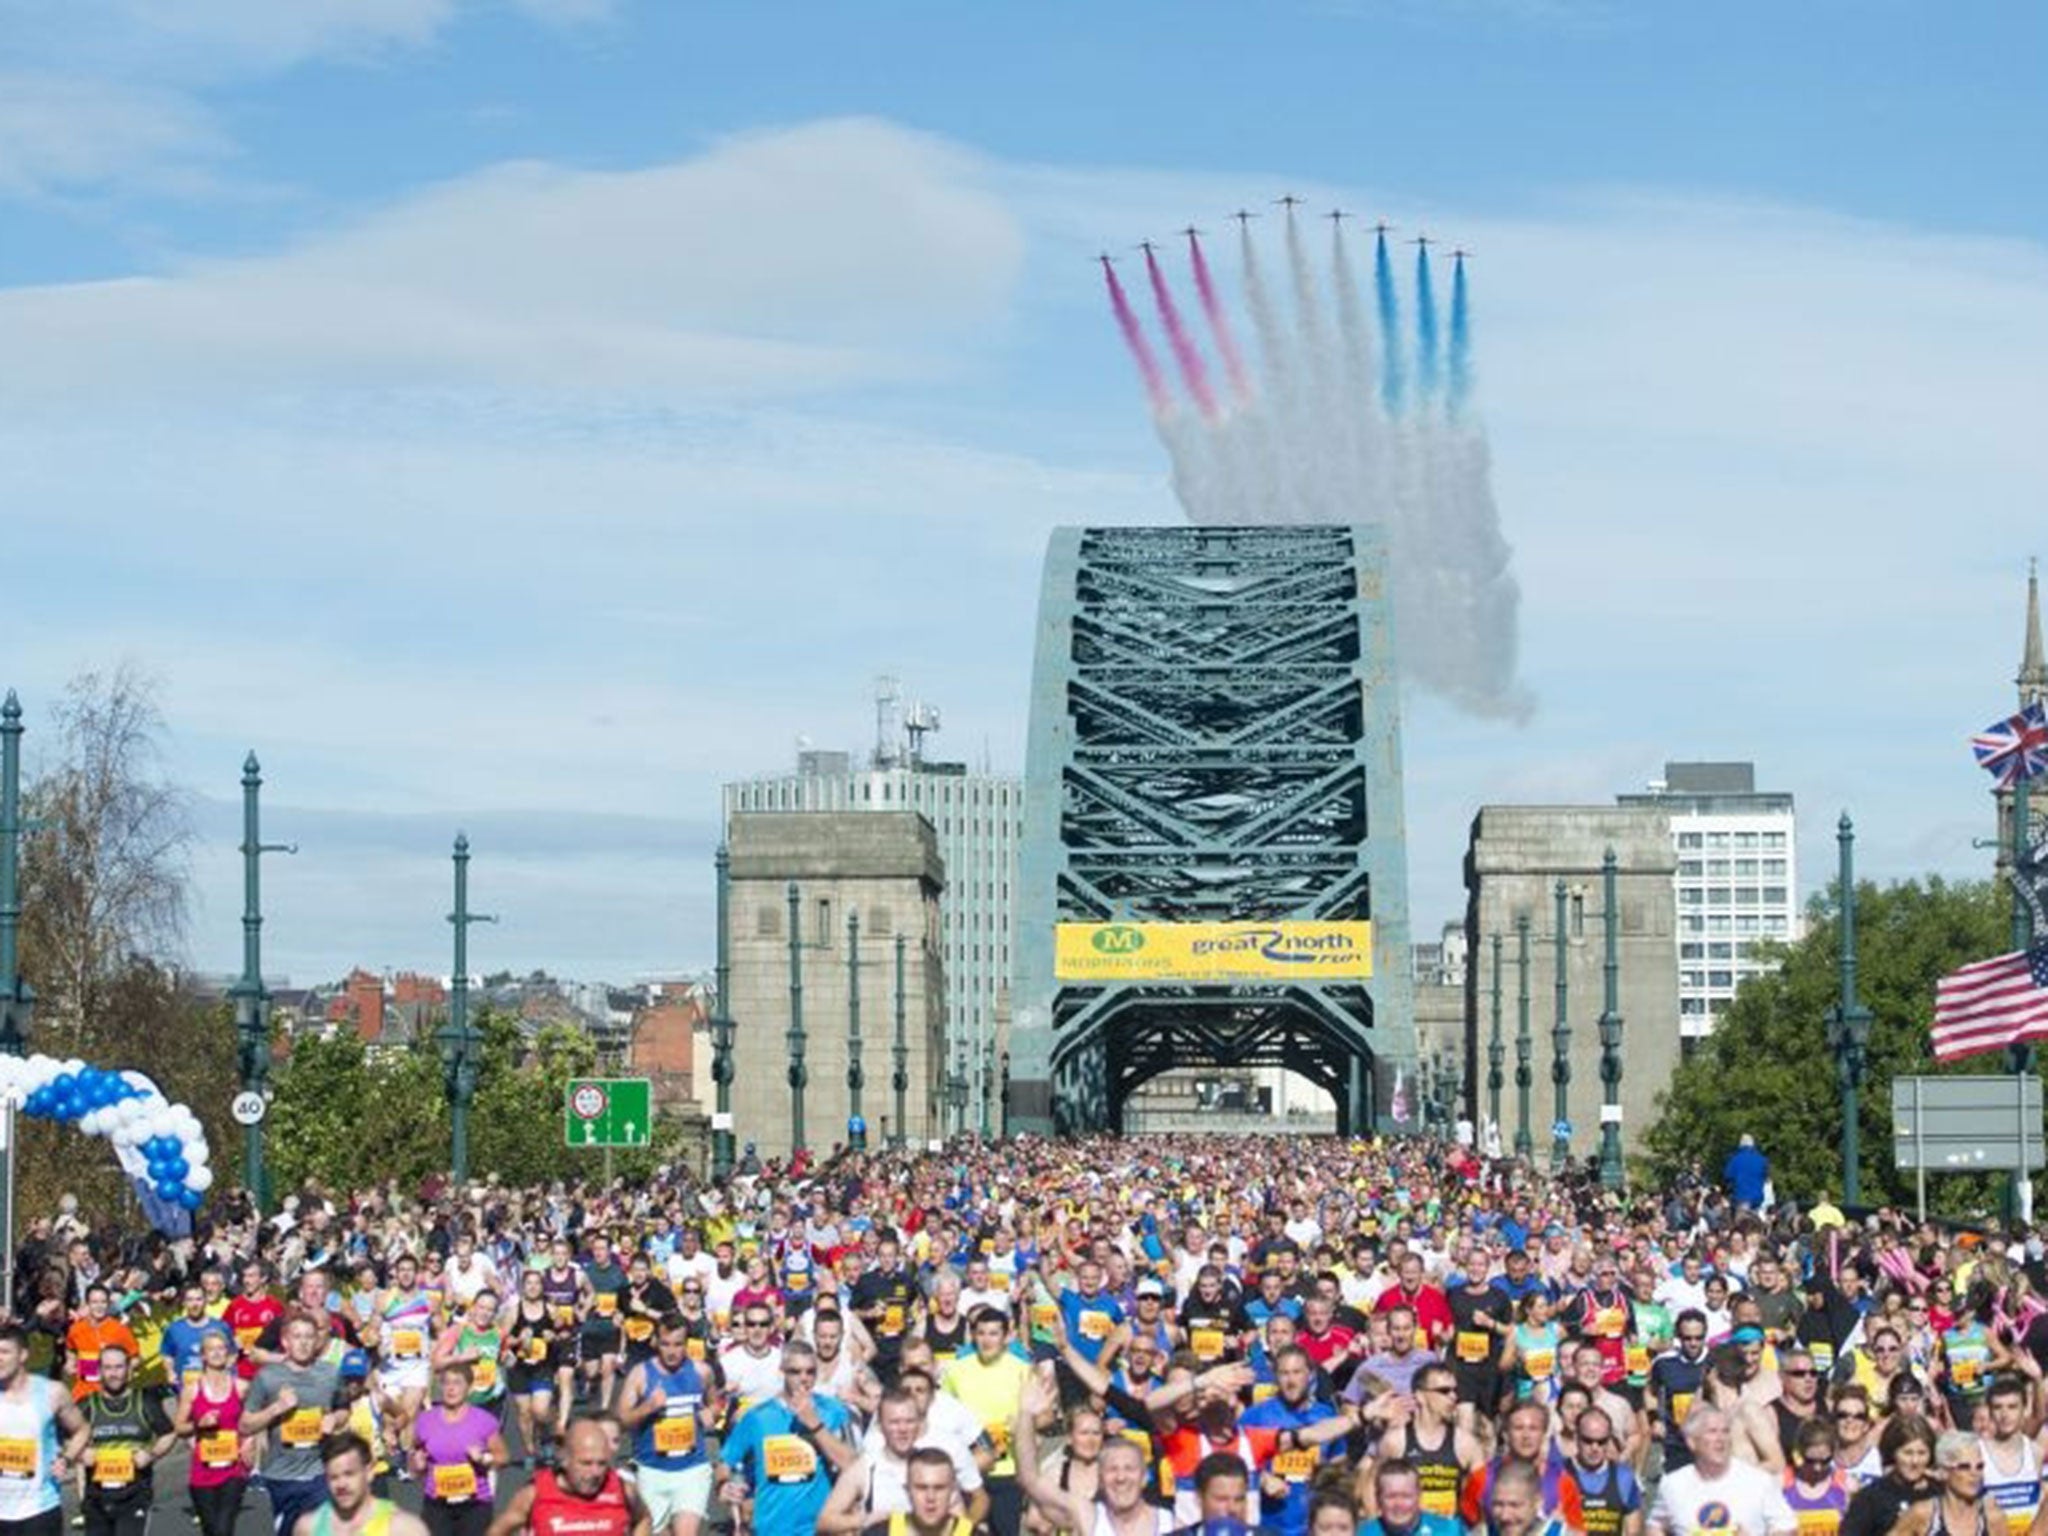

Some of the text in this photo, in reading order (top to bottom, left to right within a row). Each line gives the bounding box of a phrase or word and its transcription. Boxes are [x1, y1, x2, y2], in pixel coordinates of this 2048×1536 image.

[1192, 933, 1353, 954] great north
[1062, 957, 1173, 969] MORRISONS
[1319, 954, 1362, 964] run
[238, 1101, 260, 1114] 40
